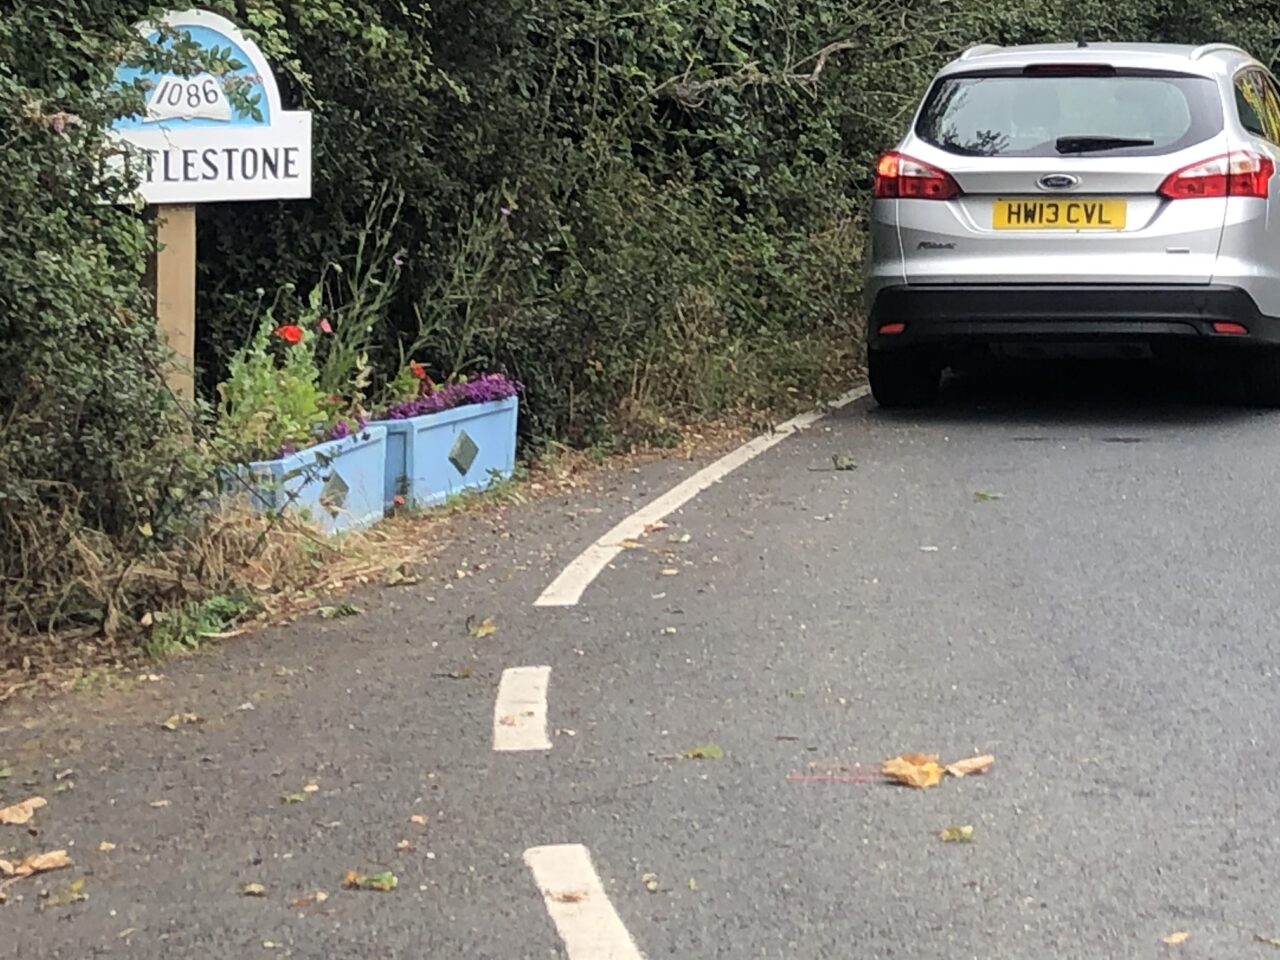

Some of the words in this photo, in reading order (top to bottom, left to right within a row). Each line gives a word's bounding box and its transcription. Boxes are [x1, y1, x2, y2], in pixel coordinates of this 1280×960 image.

[156, 80, 218, 108] 1086
[100, 147, 299, 183] TLESTONE
[1007, 202, 1059, 224] HW13
[1067, 202, 1111, 224] CVL
